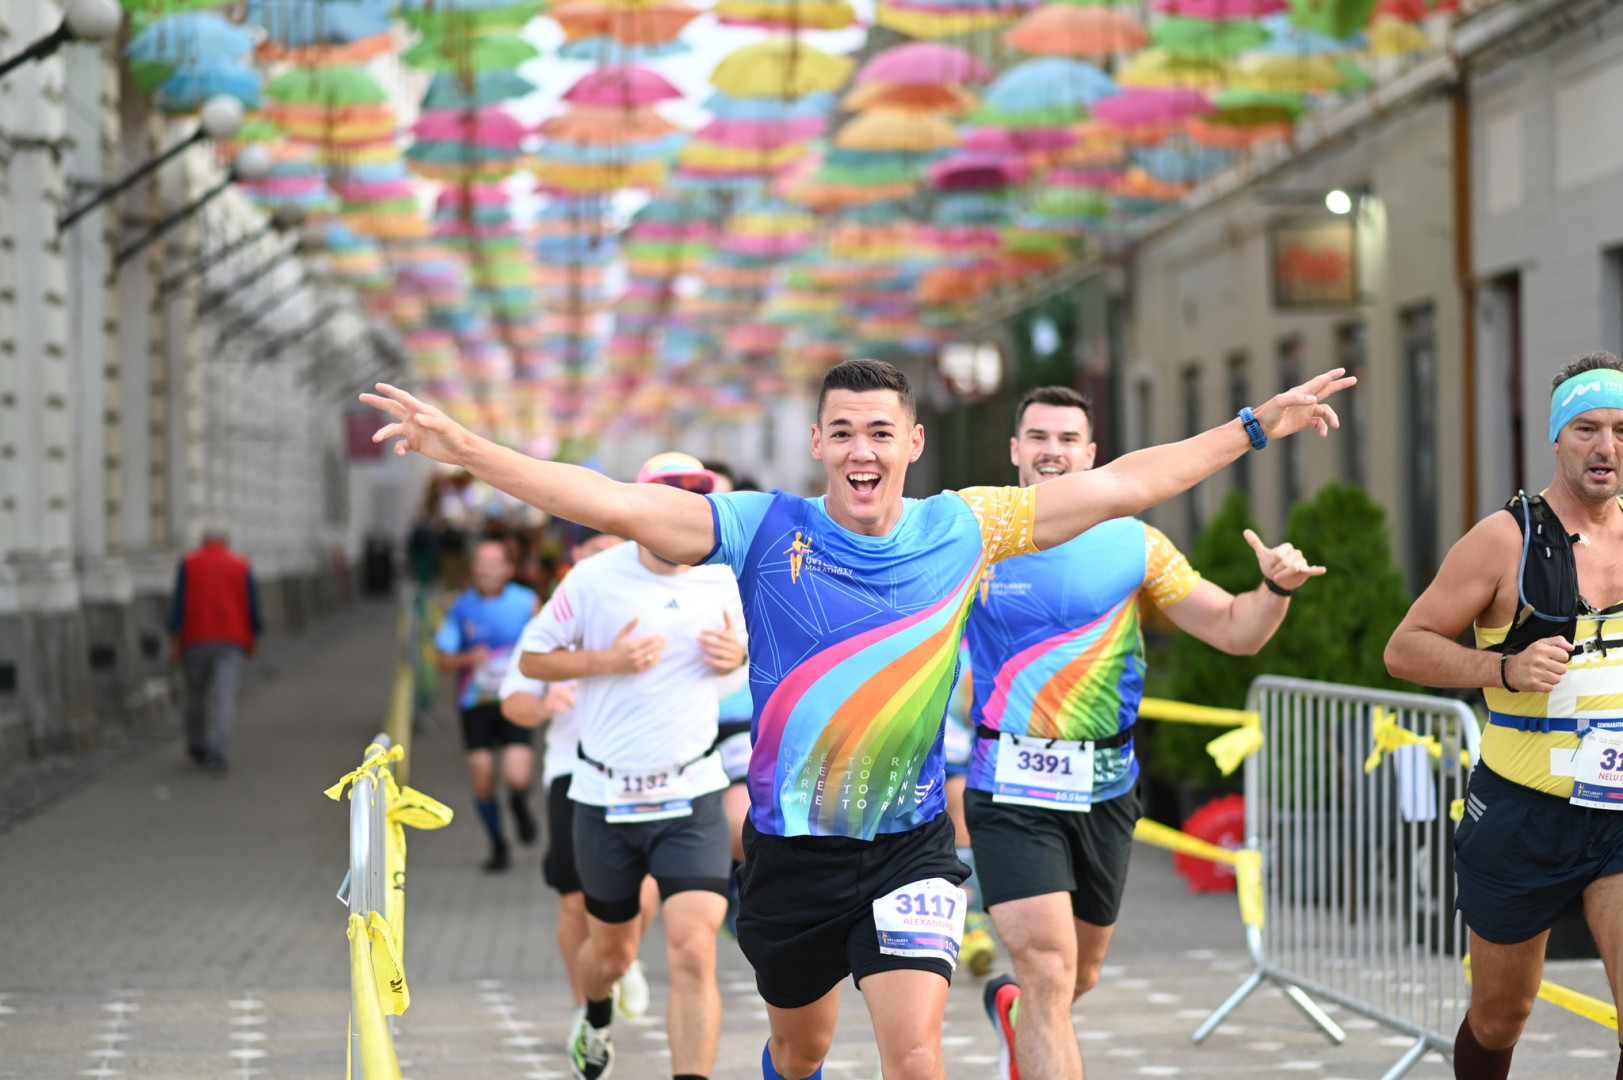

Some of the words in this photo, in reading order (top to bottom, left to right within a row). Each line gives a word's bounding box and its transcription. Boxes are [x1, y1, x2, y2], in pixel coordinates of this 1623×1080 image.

[1016, 750, 1073, 776] 3391
[845, 770, 870, 781] TO
[1598, 772, 1620, 781] NELU
[843, 784, 869, 795] TO
[842, 799, 867, 810] TO
[894, 892, 956, 920] 3117
